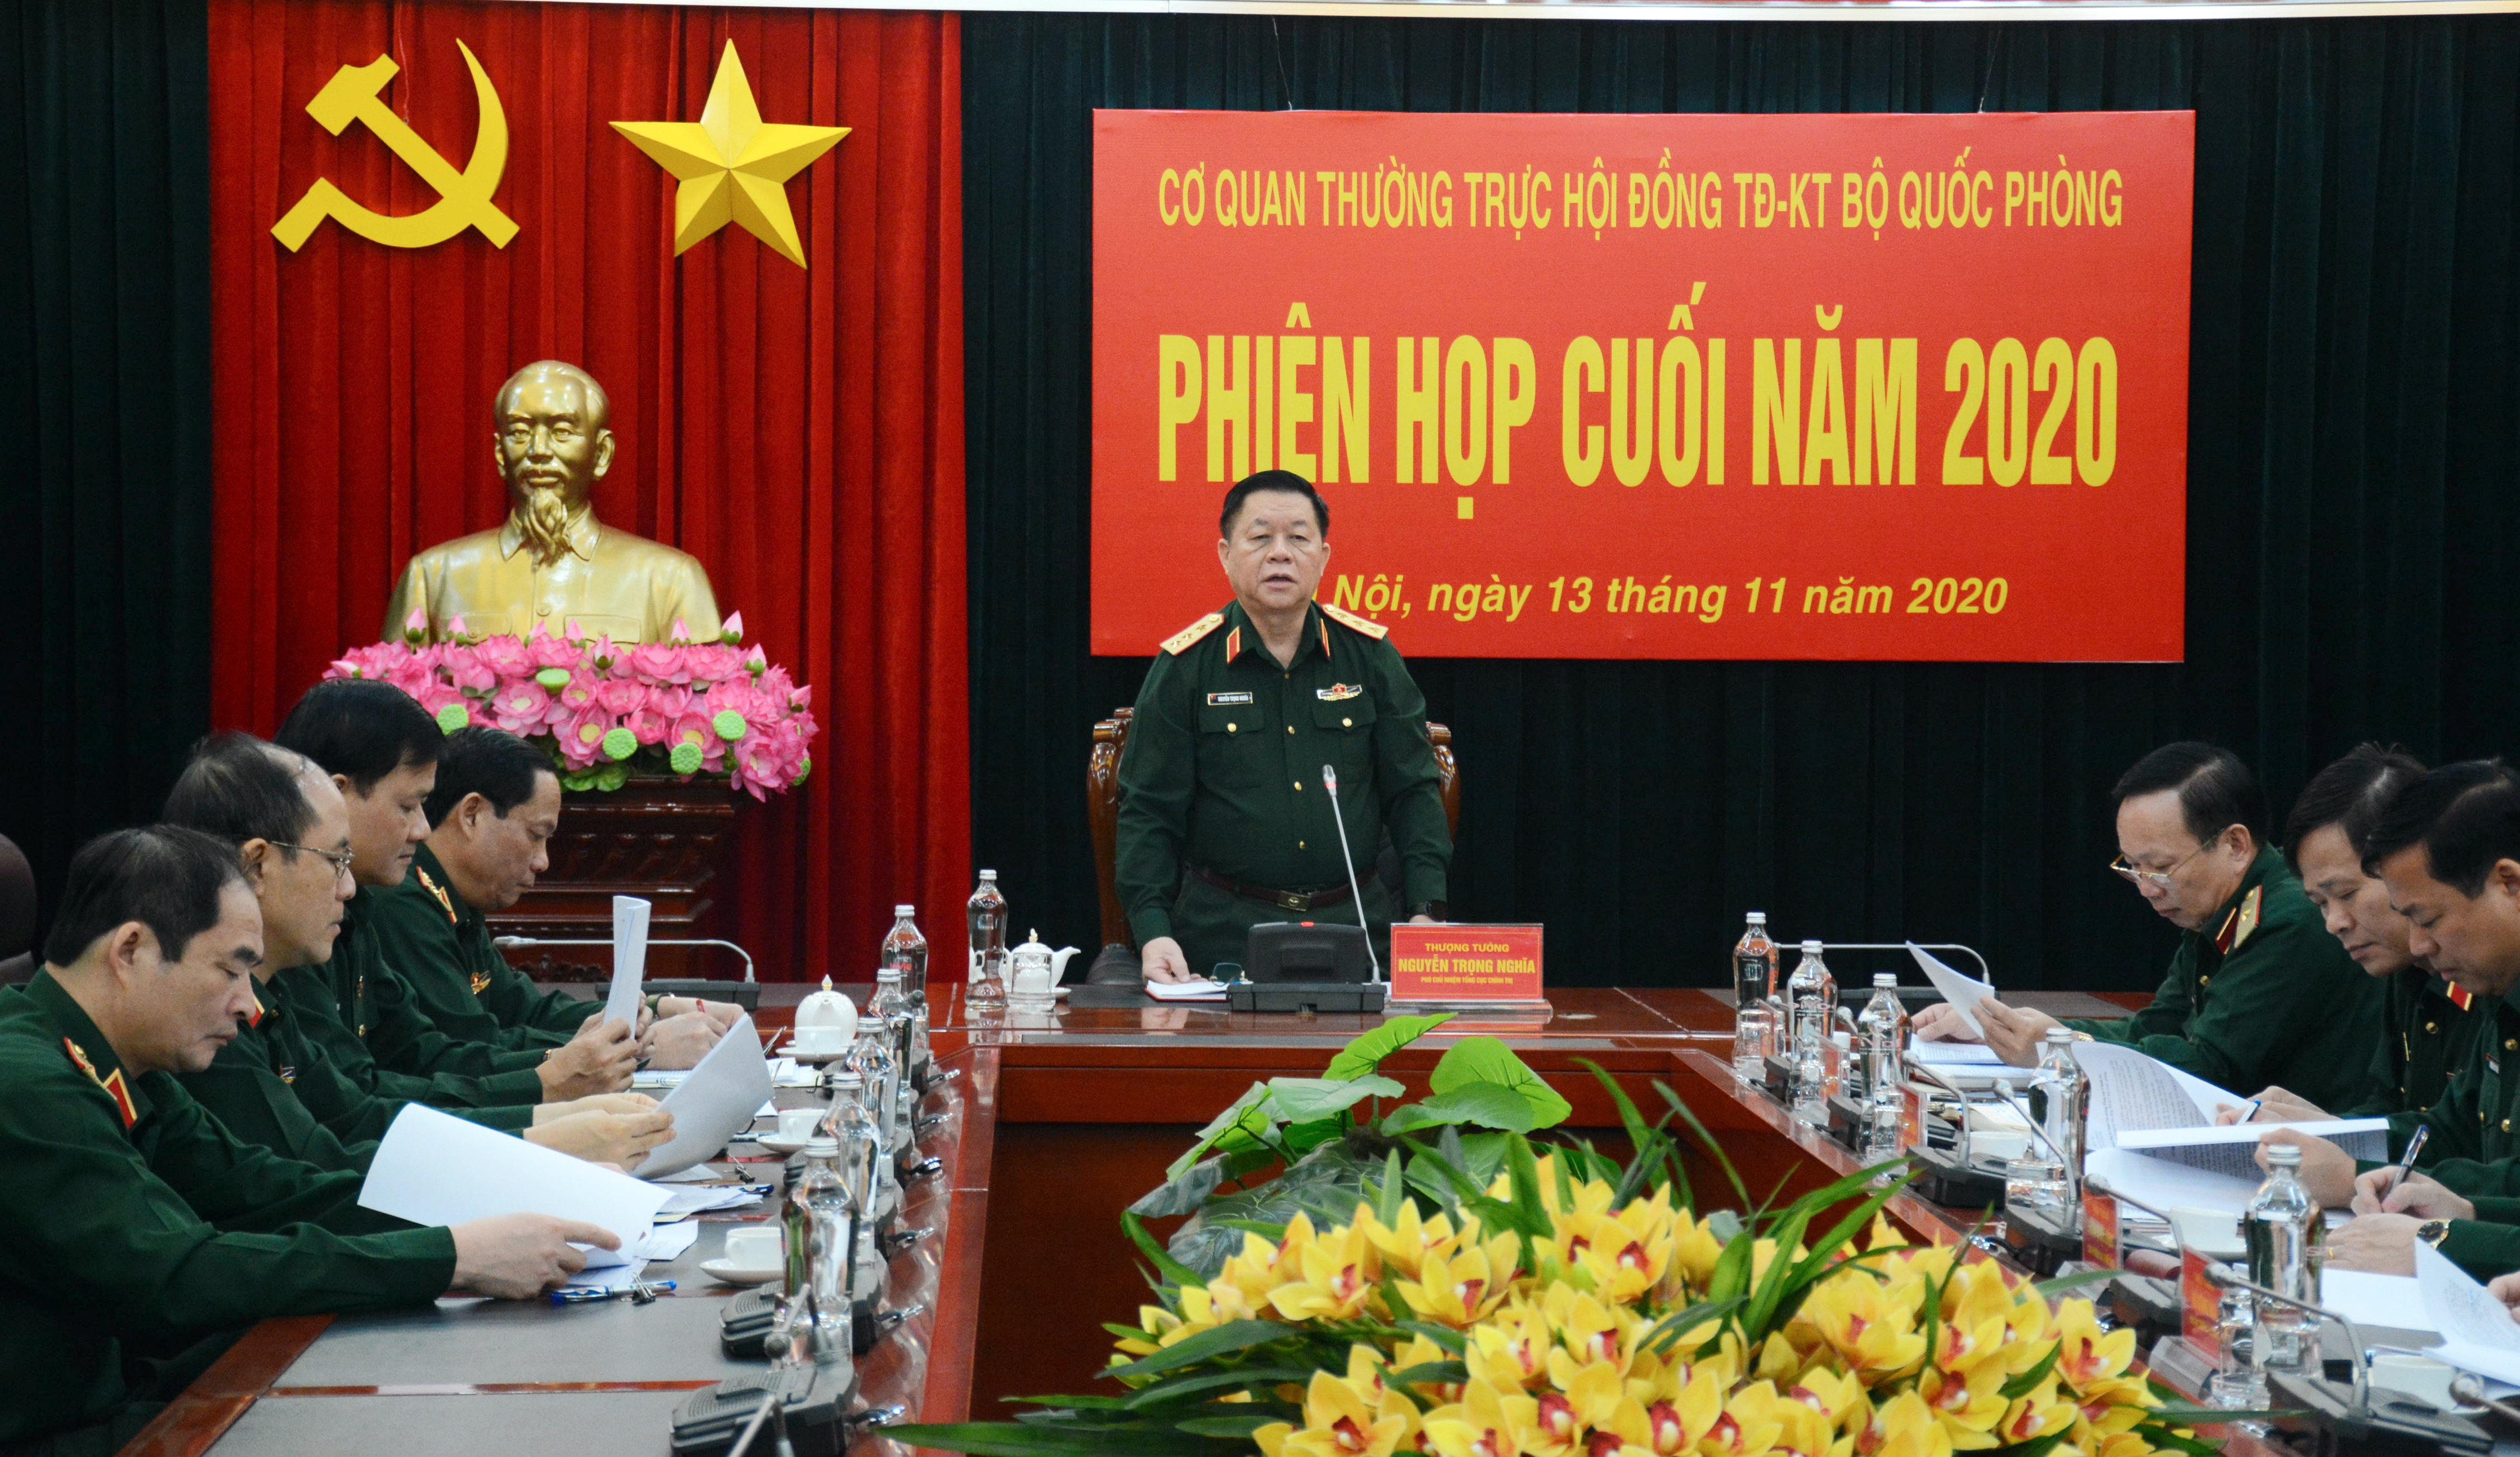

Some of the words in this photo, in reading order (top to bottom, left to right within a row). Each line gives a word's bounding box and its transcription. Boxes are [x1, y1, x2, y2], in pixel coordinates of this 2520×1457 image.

[1158, 162, 1206, 226] CƠ
[1215, 168, 1305, 228] QUAN
[1316, 155, 1453, 228] THƯỜNG
[1463, 164, 1552, 240] TRỰC
[1563, 157, 1618, 240] HỘI
[1627, 147, 1722, 230] ĐỒNG
[1733, 172, 1832, 228] TĐ-KT
[1842, 156, 1889, 240] BỘ
[1899, 146, 1994, 230] QUỐC
[2005, 154, 2123, 227] PHÒNG
[1158, 302, 1370, 484] PHIÊN
[1396, 334, 1536, 520] HỌP
[1562, 281, 1726, 488] CUỐI
[1752, 304, 1918, 485] NĂM
[1942, 337, 2118, 487] 2020
[1333, 574, 1411, 619] Nội,
[1427, 574, 1533, 622] ngày
[1549, 576, 1593, 613] 13
[1607, 575, 1727, 623] tháng
[1745, 577, 1786, 613] 11
[1803, 576, 1893, 614] năm
[1906, 578, 2008, 614] 2020
[1398, 954, 1449, 972] NGUYỄN
[1452, 958, 1493, 975] TRỌNG
[1497, 957, 1536, 973] NGHĨA
[1425, 943, 1470, 954] THƯỢNG
